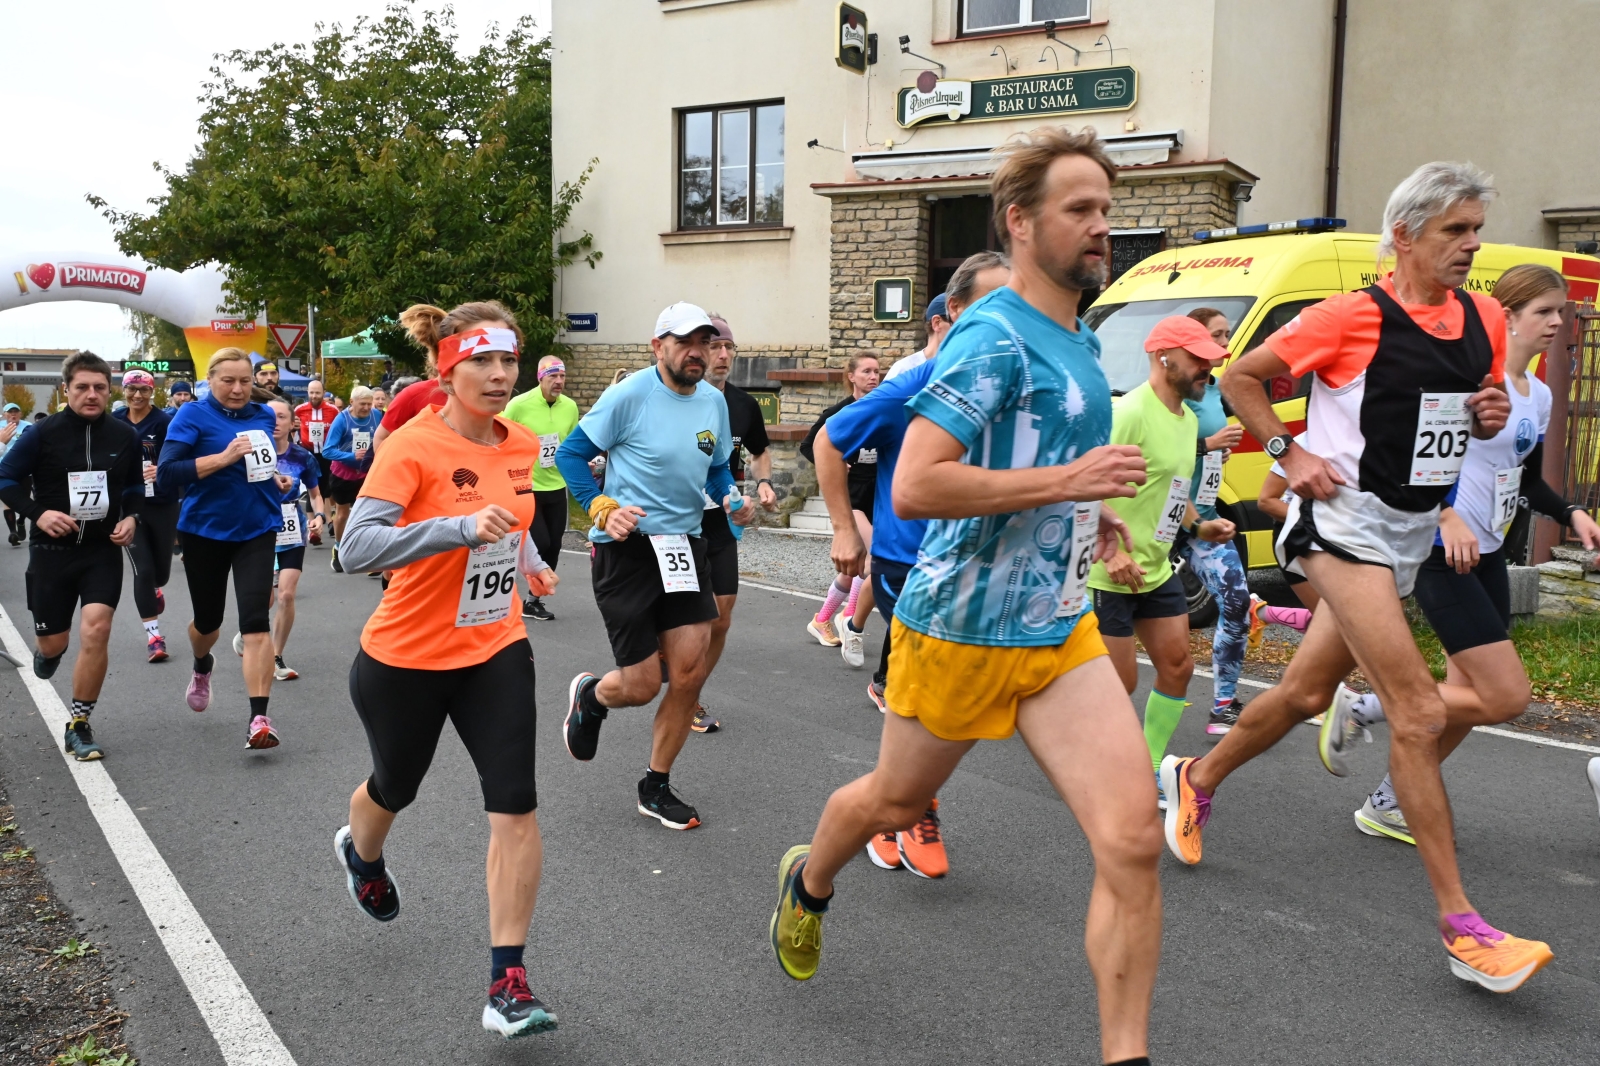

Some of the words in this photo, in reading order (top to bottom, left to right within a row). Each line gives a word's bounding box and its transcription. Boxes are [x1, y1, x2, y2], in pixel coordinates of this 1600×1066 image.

[990, 77, 1074, 97] RESTAURACE
[910, 94, 936, 115] Pilsner
[935, 91, 963, 106] Urquell
[985, 101, 995, 113] &
[998, 98, 1024, 113] BAR
[1027, 97, 1037, 110] U
[1040, 94, 1079, 109] SAMA
[63, 265, 139, 289] PRIMATOR
[213, 321, 254, 331] PRIOR
[755, 397, 770, 406] AR
[355, 441, 367, 451] 50
[542, 446, 556, 458] 22
[1416, 430, 1470, 459] 203
[251, 448, 272, 466] 18
[1205, 472, 1220, 489] 49
[77, 491, 101, 507] 77
[1168, 503, 1186, 524] 48
[497, 557, 516, 566] METUJE
[665, 552, 690, 572] 35
[466, 566, 516, 601] 196
